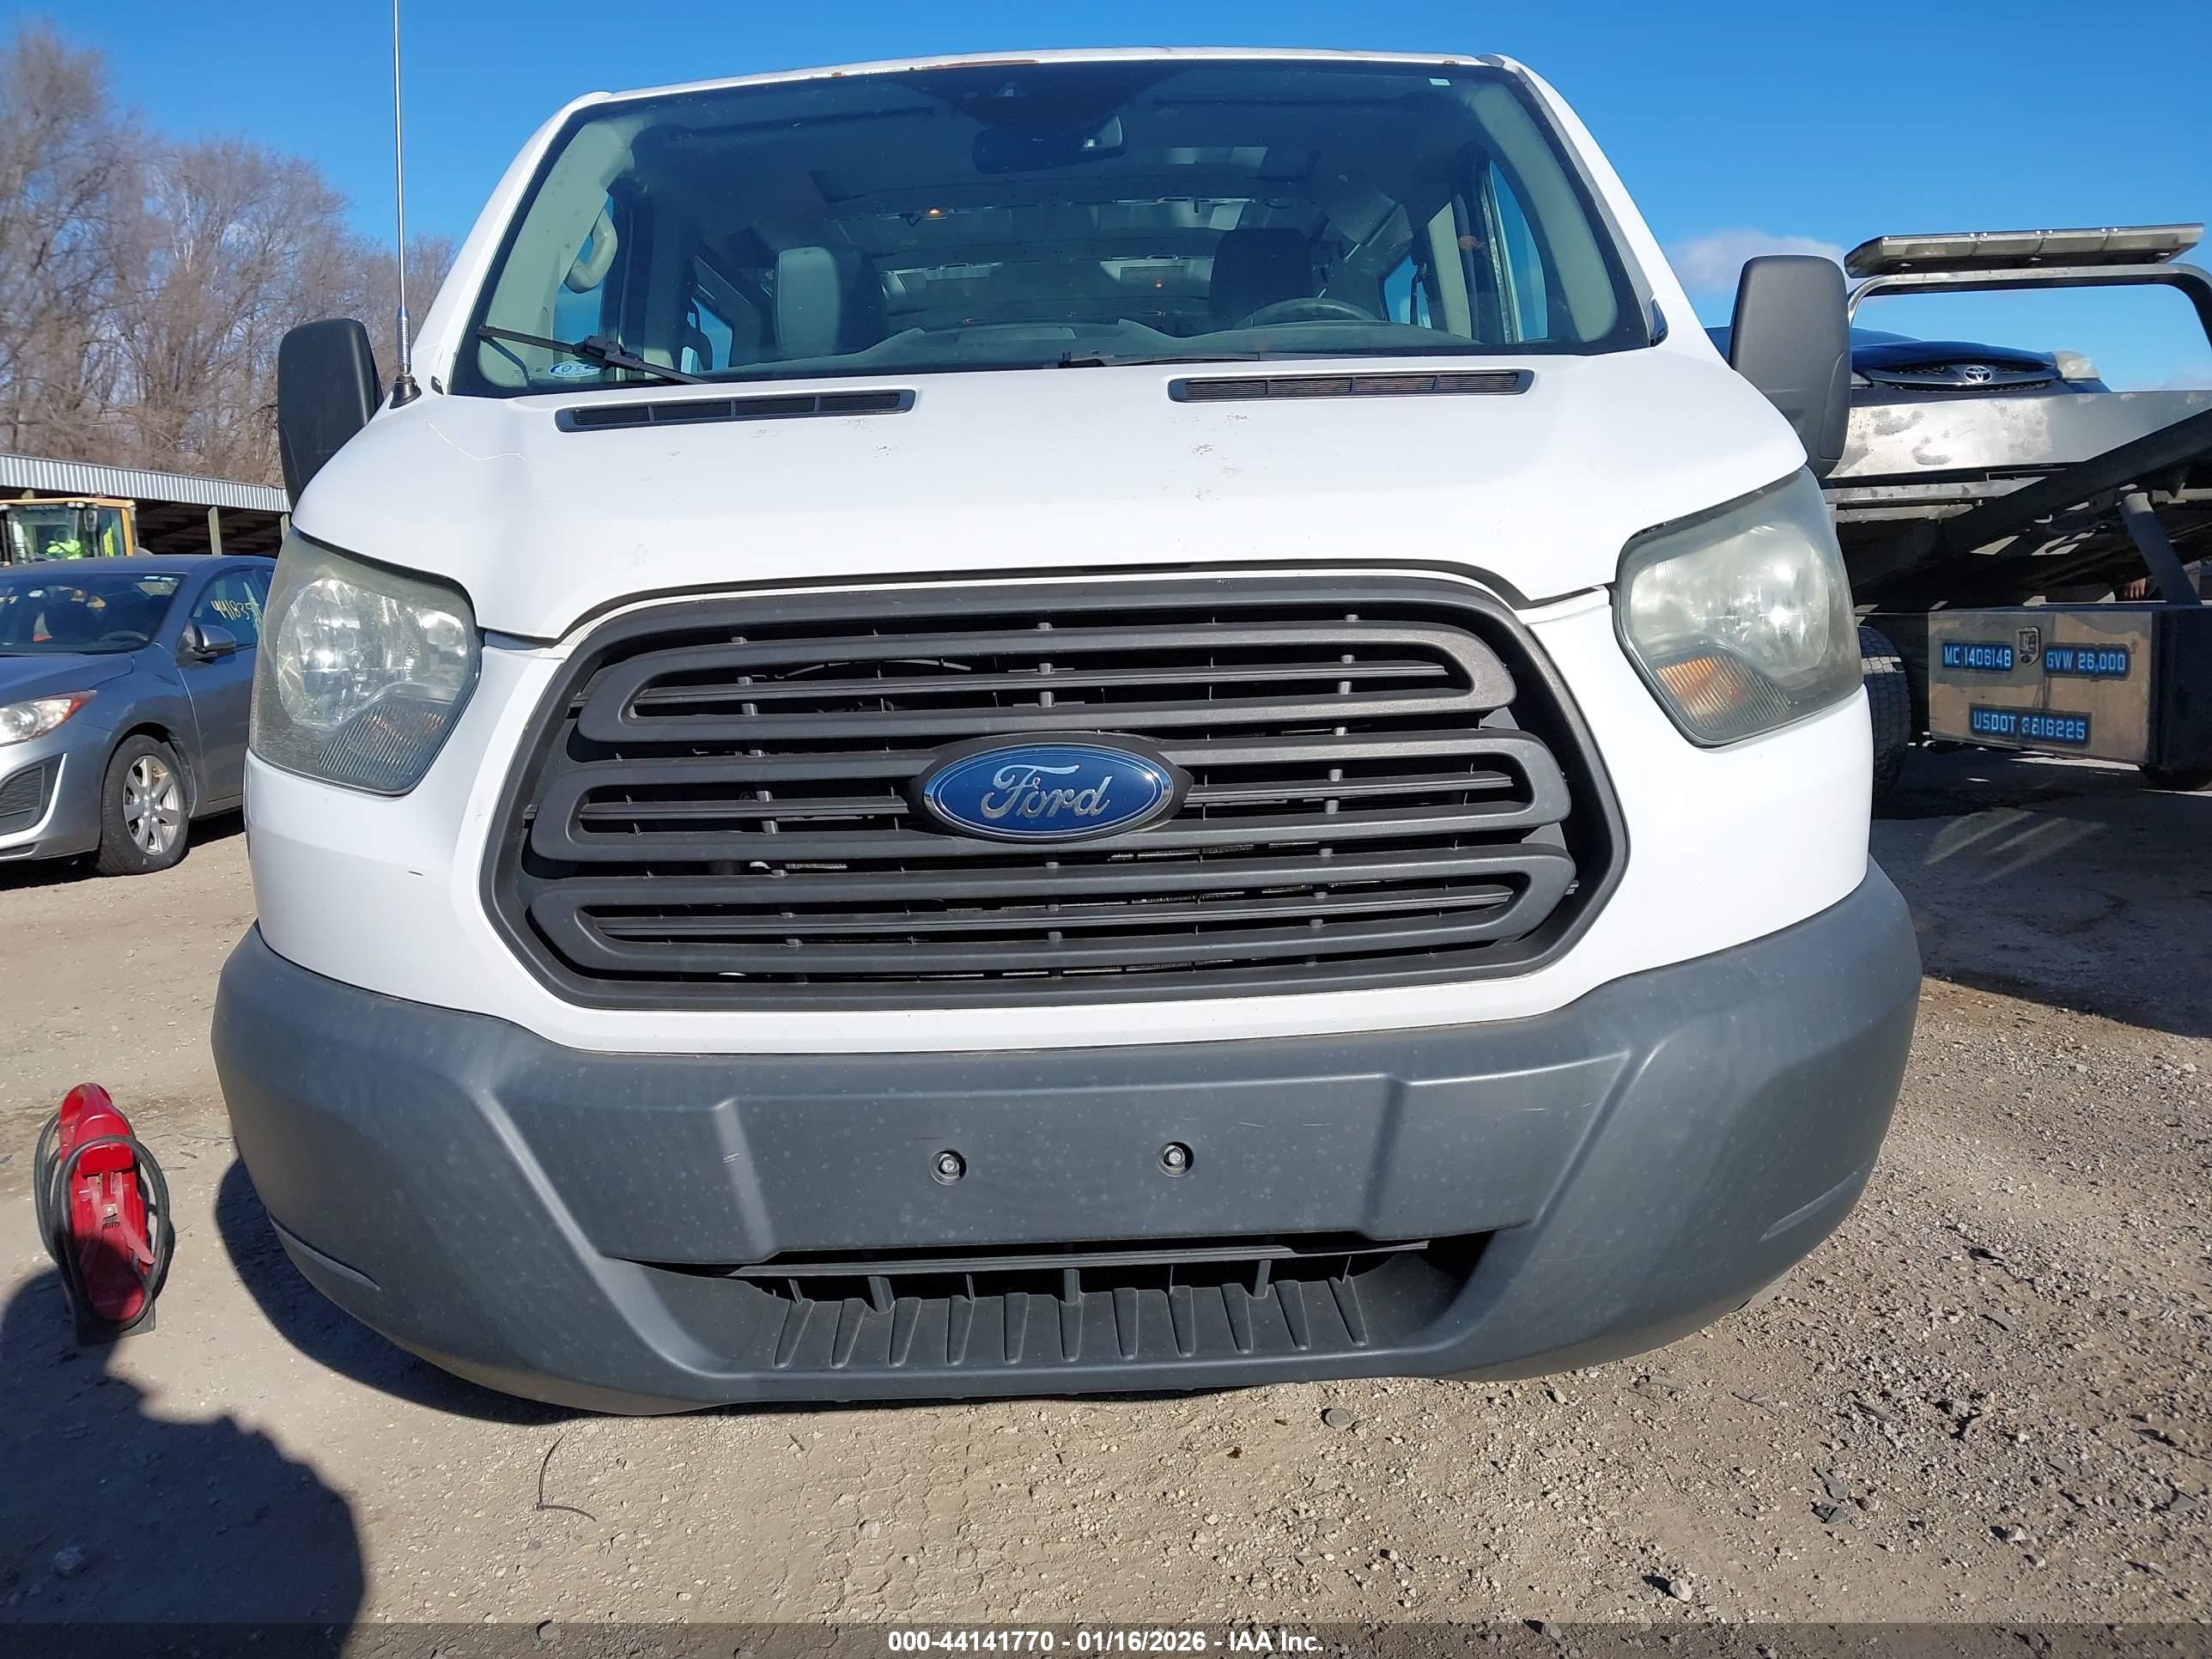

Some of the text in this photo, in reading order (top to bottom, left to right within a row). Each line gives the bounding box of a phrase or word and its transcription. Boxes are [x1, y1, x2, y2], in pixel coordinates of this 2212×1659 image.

[1943, 645, 2012, 667] MC 1406148
[2046, 652, 2126, 672] GVW 26,000
[1973, 711, 2016, 734] USDOT
[981, 763, 1114, 819] Ford
